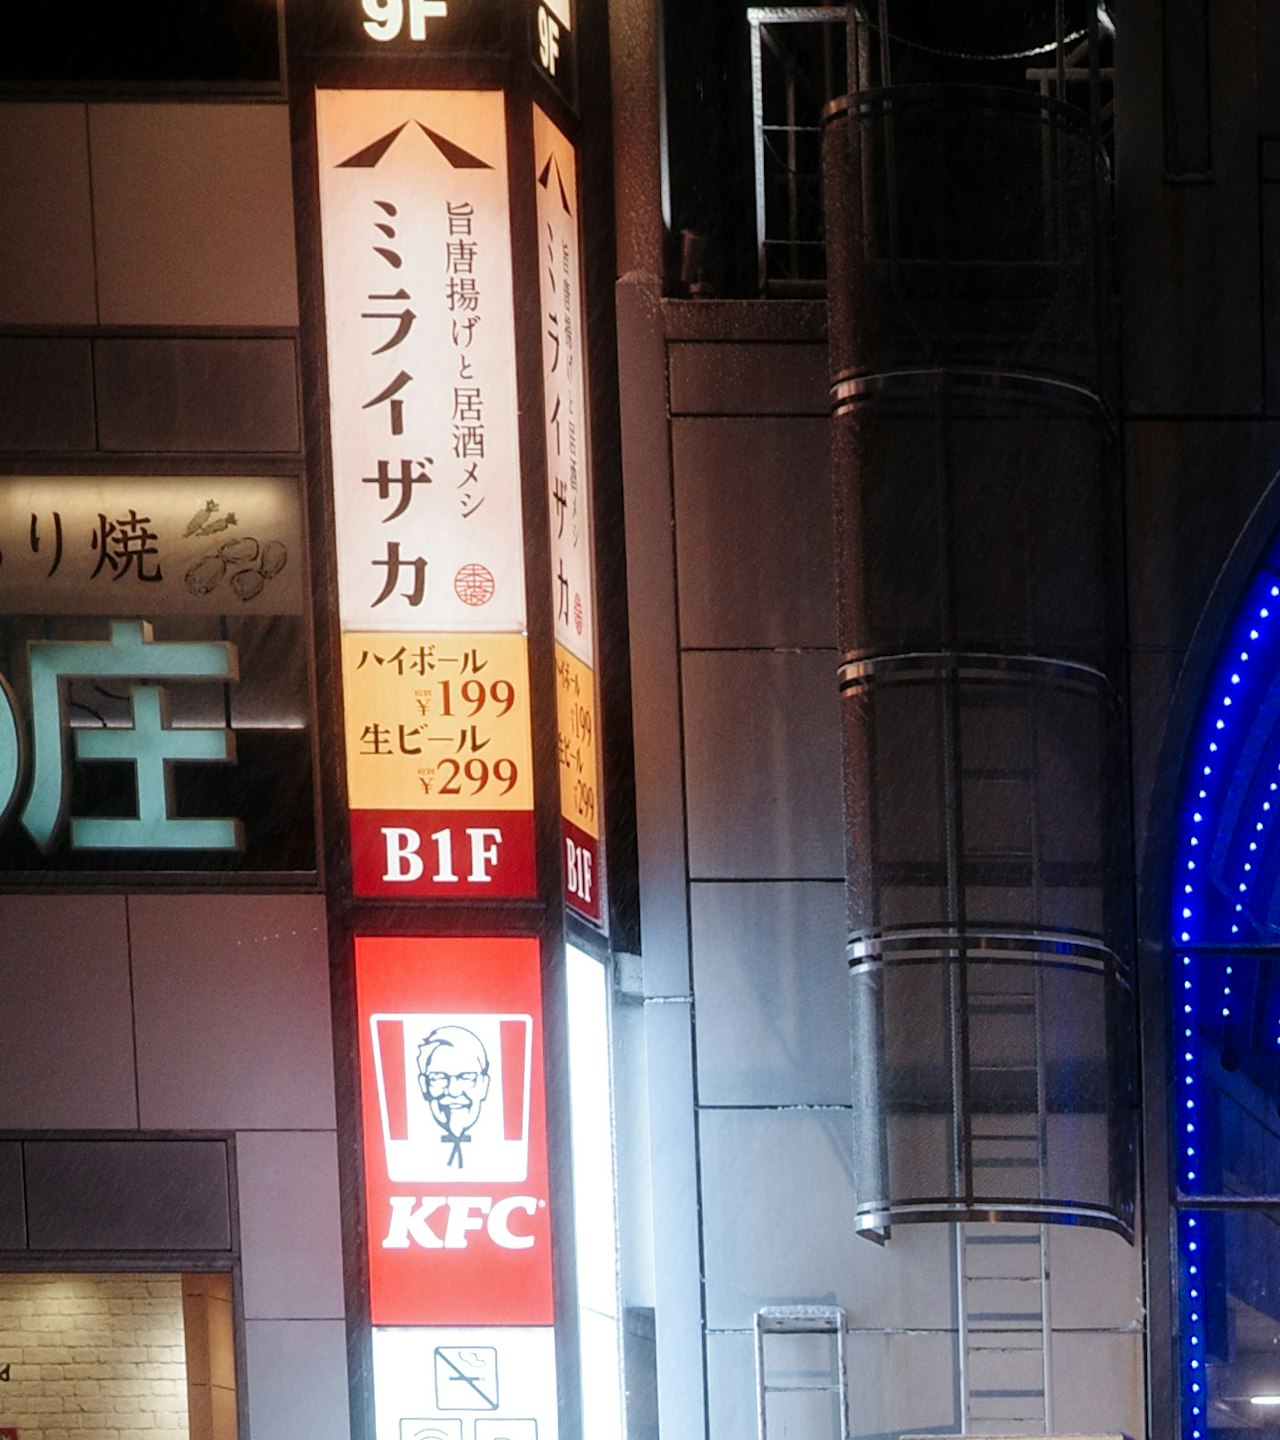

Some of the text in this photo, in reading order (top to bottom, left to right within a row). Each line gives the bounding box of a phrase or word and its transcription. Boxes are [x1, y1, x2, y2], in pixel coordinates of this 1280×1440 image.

[362, 0, 448, 41] 9F
[536, 6, 560, 77] 9F
[446, 200, 486, 520] 旨唐揚げと居酒メシ
[360, 200, 434, 608] ミライザカ
[0, 509, 164, 583] り焼
[356, 644, 489, 677] ハイボール
[416, 679, 516, 718] ¥199
[0, 619, 247, 855] 庄
[358, 722, 492, 756] 生ビール
[418, 757, 519, 797] ¥299
[380, 826, 503, 883] B1F
[565, 837, 594, 904] B1F
[382, 1195, 538, 1250] KFC
